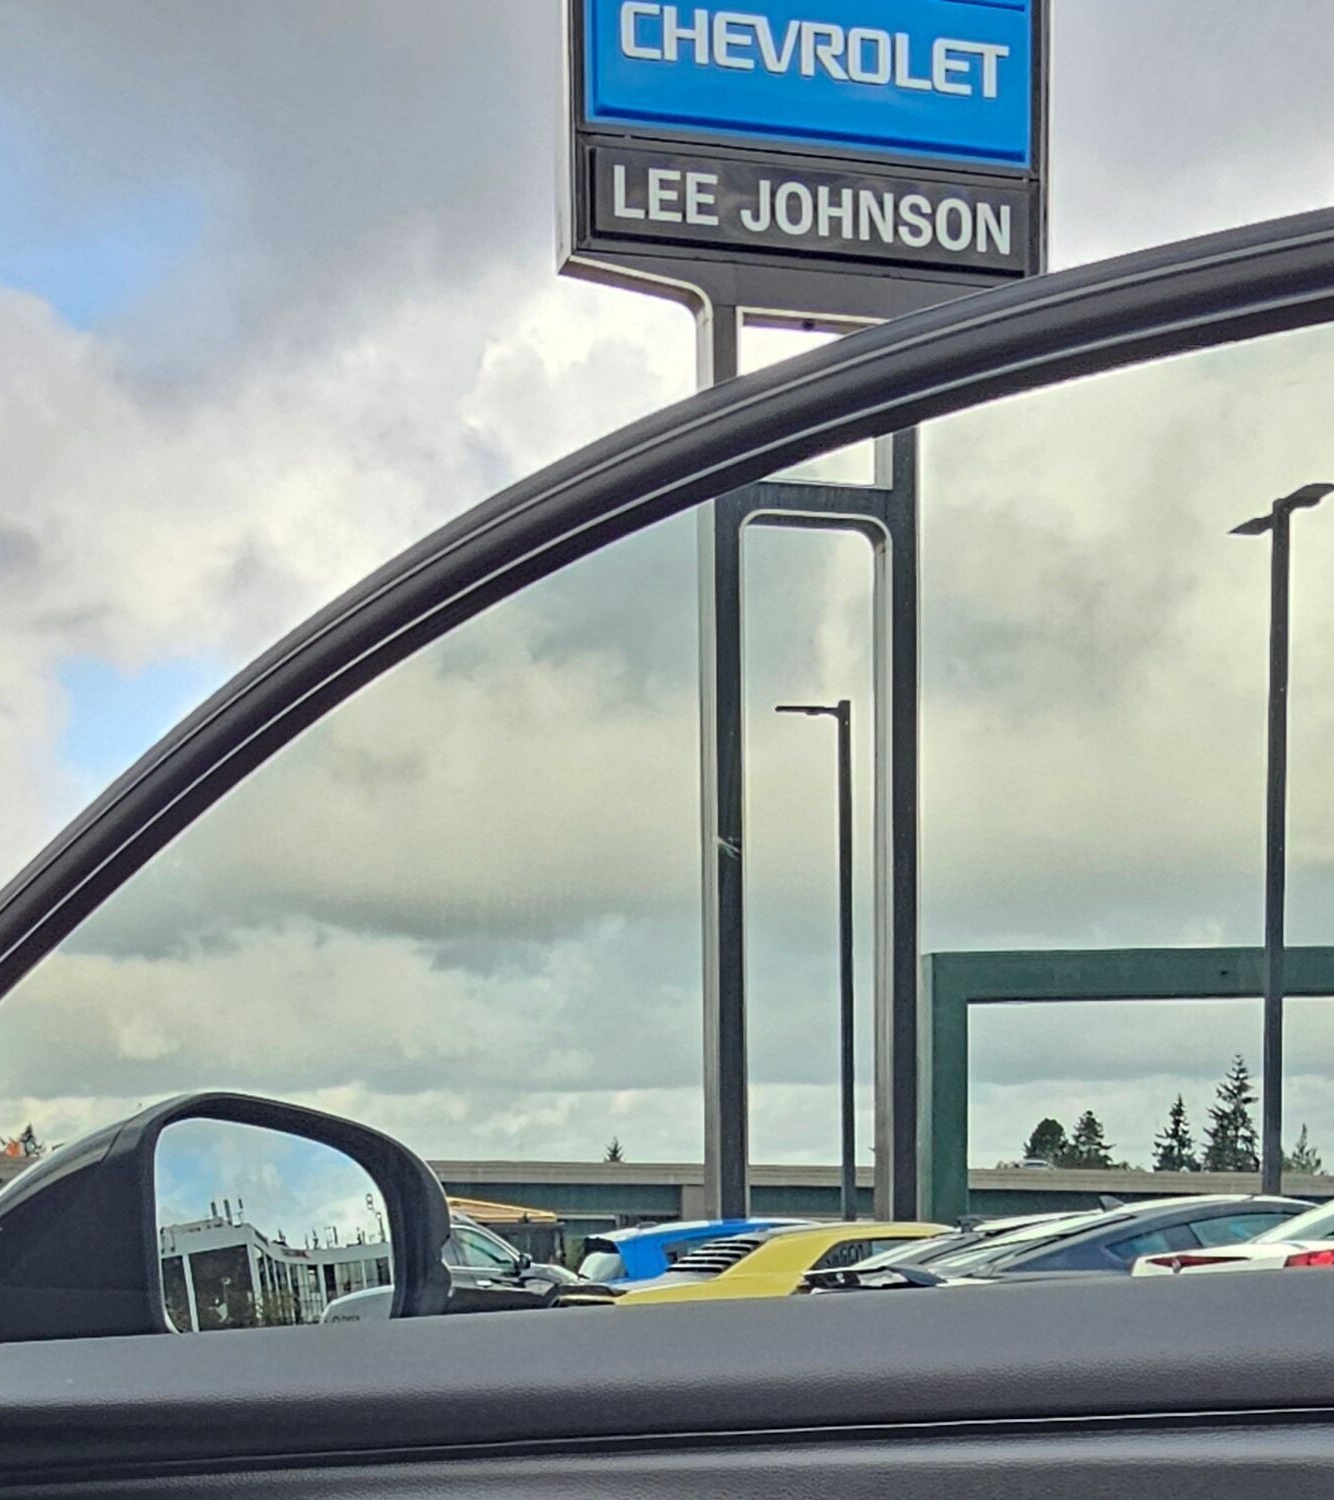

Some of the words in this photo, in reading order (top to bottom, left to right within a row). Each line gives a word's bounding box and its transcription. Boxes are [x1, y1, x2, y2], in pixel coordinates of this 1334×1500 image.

[620, 1, 1010, 99] CHEVROLET
[613, 165, 719, 226] LEE
[740, 179, 1011, 255] JOHNSON
